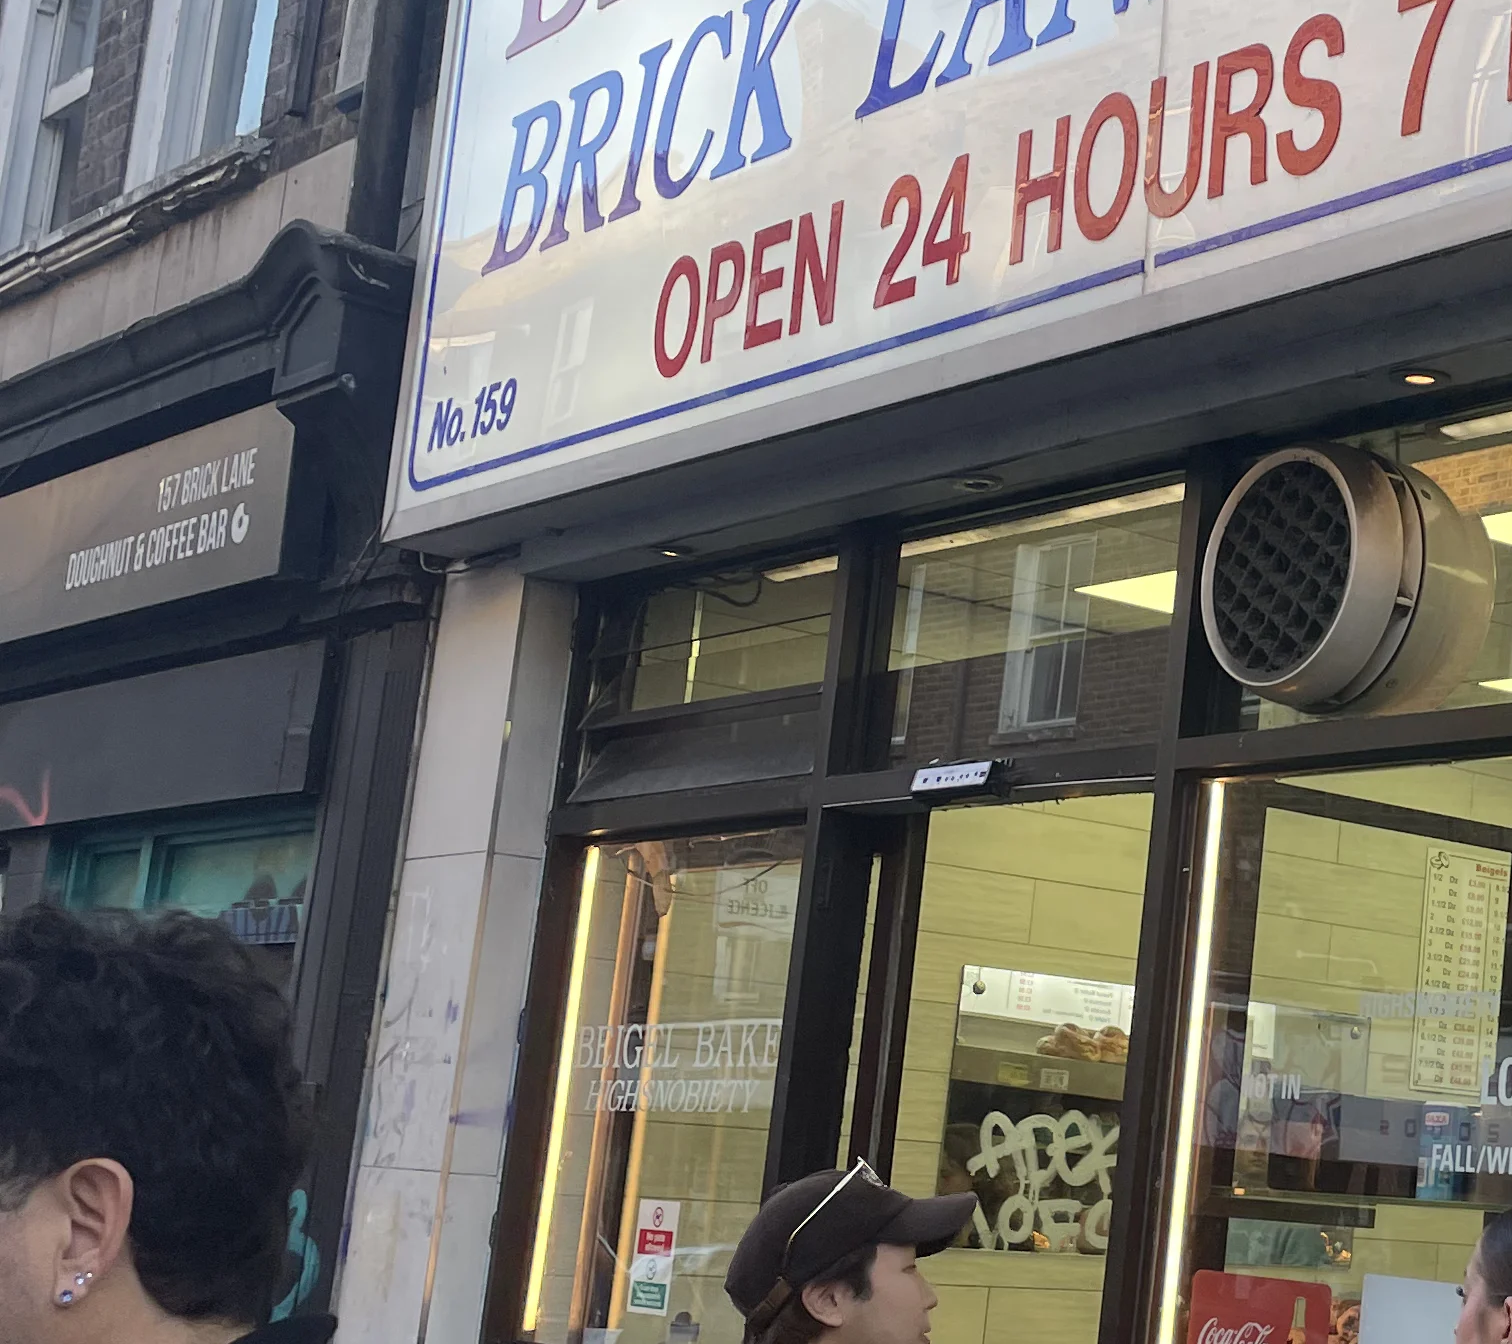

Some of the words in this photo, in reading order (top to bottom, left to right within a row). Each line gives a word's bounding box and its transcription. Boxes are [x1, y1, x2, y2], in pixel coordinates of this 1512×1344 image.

[653, 199, 845, 378] OPEN
[874, 152, 971, 309] 24
[1008, 13, 1346, 267] HOURS
[472, 378, 518, 437] 159
[157, 472, 182, 513] 157
[181, 460, 222, 506] BRICK
[220, 447, 258, 494] LANE
[65, 536, 135, 591] DOUGHNUT
[134, 533, 146, 572] &
[145, 517, 198, 568] COFFEE
[196, 508, 229, 554] BAR
[576, 1023, 681, 1069] BEIGEL
[692, 1023, 784, 1068] BAKE
[584, 1079, 761, 1113] HIGHSNOBIETY
[1281, 1074, 1301, 1100] IN
